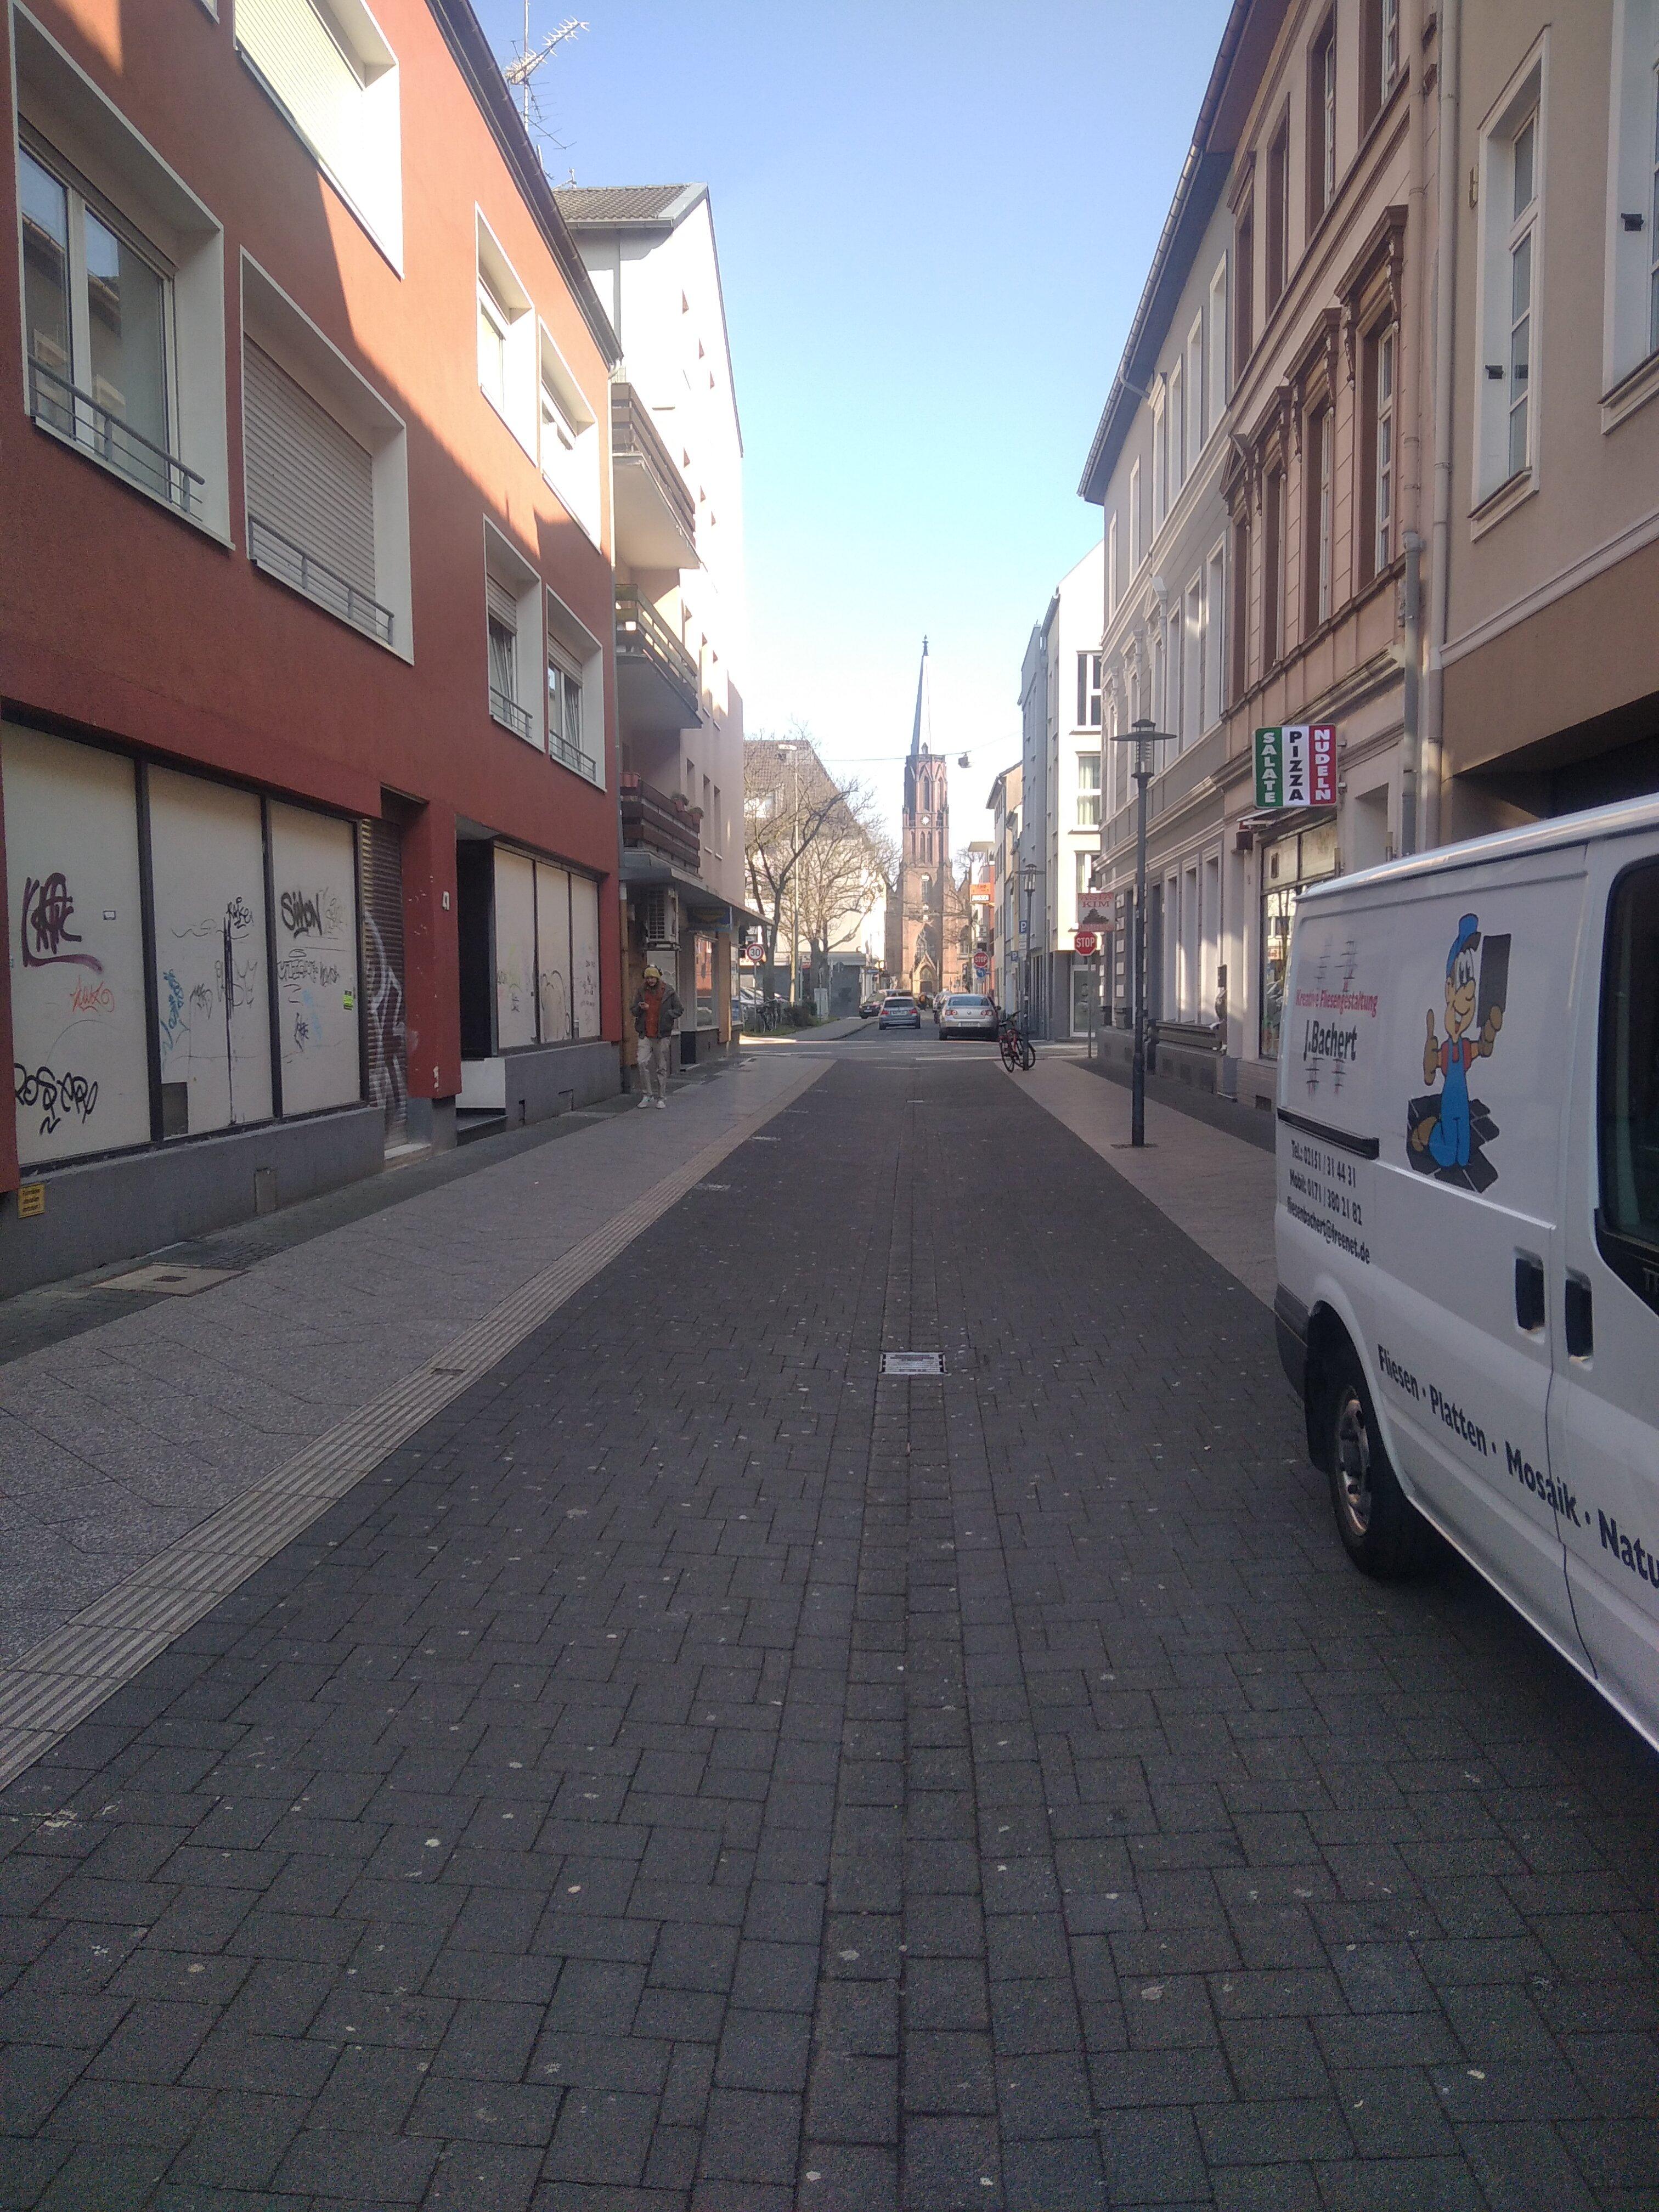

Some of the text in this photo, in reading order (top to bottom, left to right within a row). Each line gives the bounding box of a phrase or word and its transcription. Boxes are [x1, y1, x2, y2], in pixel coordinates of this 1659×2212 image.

[1261, 732, 1278, 803] SALATE
[1289, 731, 1304, 800] PIZZA
[1314, 729, 1331, 800] NUDELN
[1076, 937, 1095, 948] STOP
[1320, 990, 1378, 1018] Fliesengestaltung
[1307, 1178, 1322, 1203] 0171
[1327, 1156, 1334, 1178] 31
[1337, 1161, 1346, 1183] 44
[1348, 1165, 1356, 1188] 31
[1378, 1344, 1420, 1401] Fliesen
[1429, 1384, 1487, 1457] Platten
[1505, 1441, 1581, 1528] Mosaik
